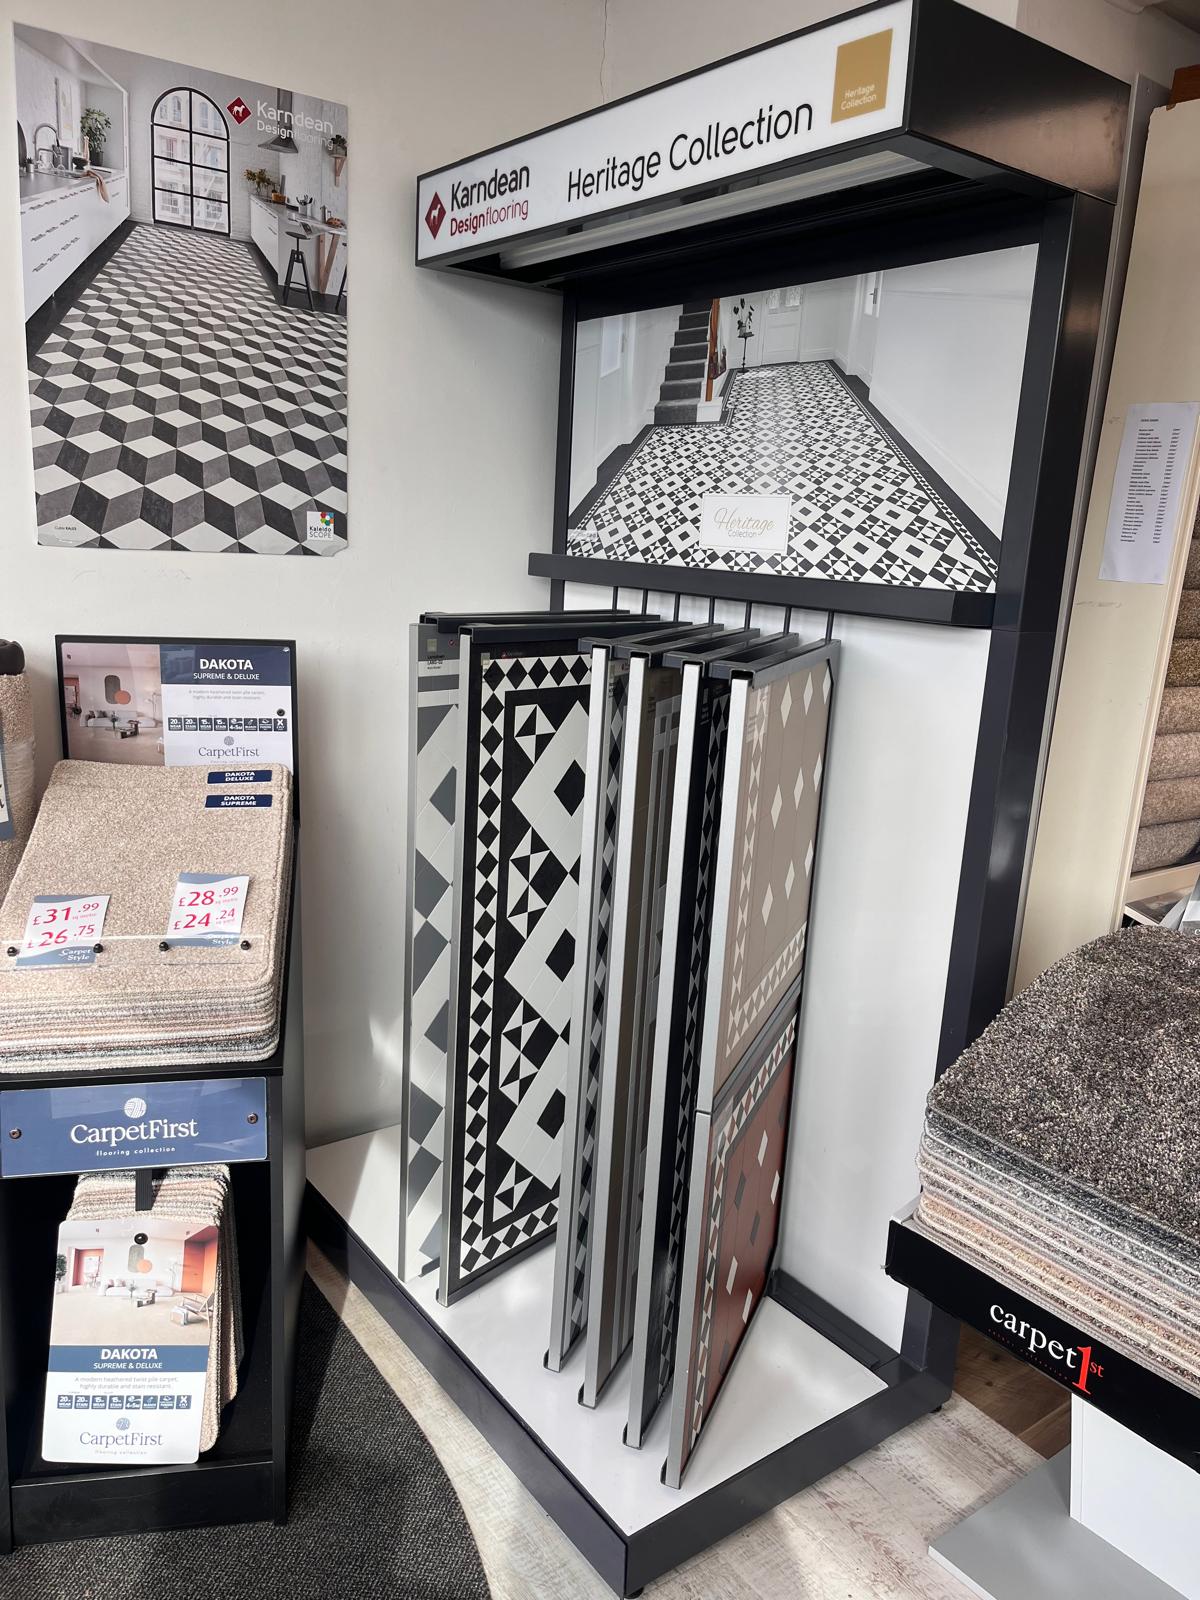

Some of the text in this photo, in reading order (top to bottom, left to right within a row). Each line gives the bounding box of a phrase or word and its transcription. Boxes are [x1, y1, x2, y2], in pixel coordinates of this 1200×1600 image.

[840, 94, 877, 110] Collection
[845, 84, 876, 100] Heritage
[257, 100, 333, 134] Karndean
[567, 103, 813, 203] Heritage Collection
[451, 166, 530, 212] Karndean
[450, 200, 529, 236] Designflooring
[713, 506, 774, 536] Heritage
[199, 659, 254, 670] DAKOTA
[193, 672, 226, 680] SUPREME
[198, 747, 260, 758] CarpetFirst
[178, 886, 239, 907] £28.99
[33, 903, 99, 926] £31.99
[174, 908, 235, 930] £24.24
[70, 1118, 199, 1147] CarpetFirst
[100, 1348, 158, 1360] DAKOTA
[79, 1431, 163, 1448] CarpetFirst
